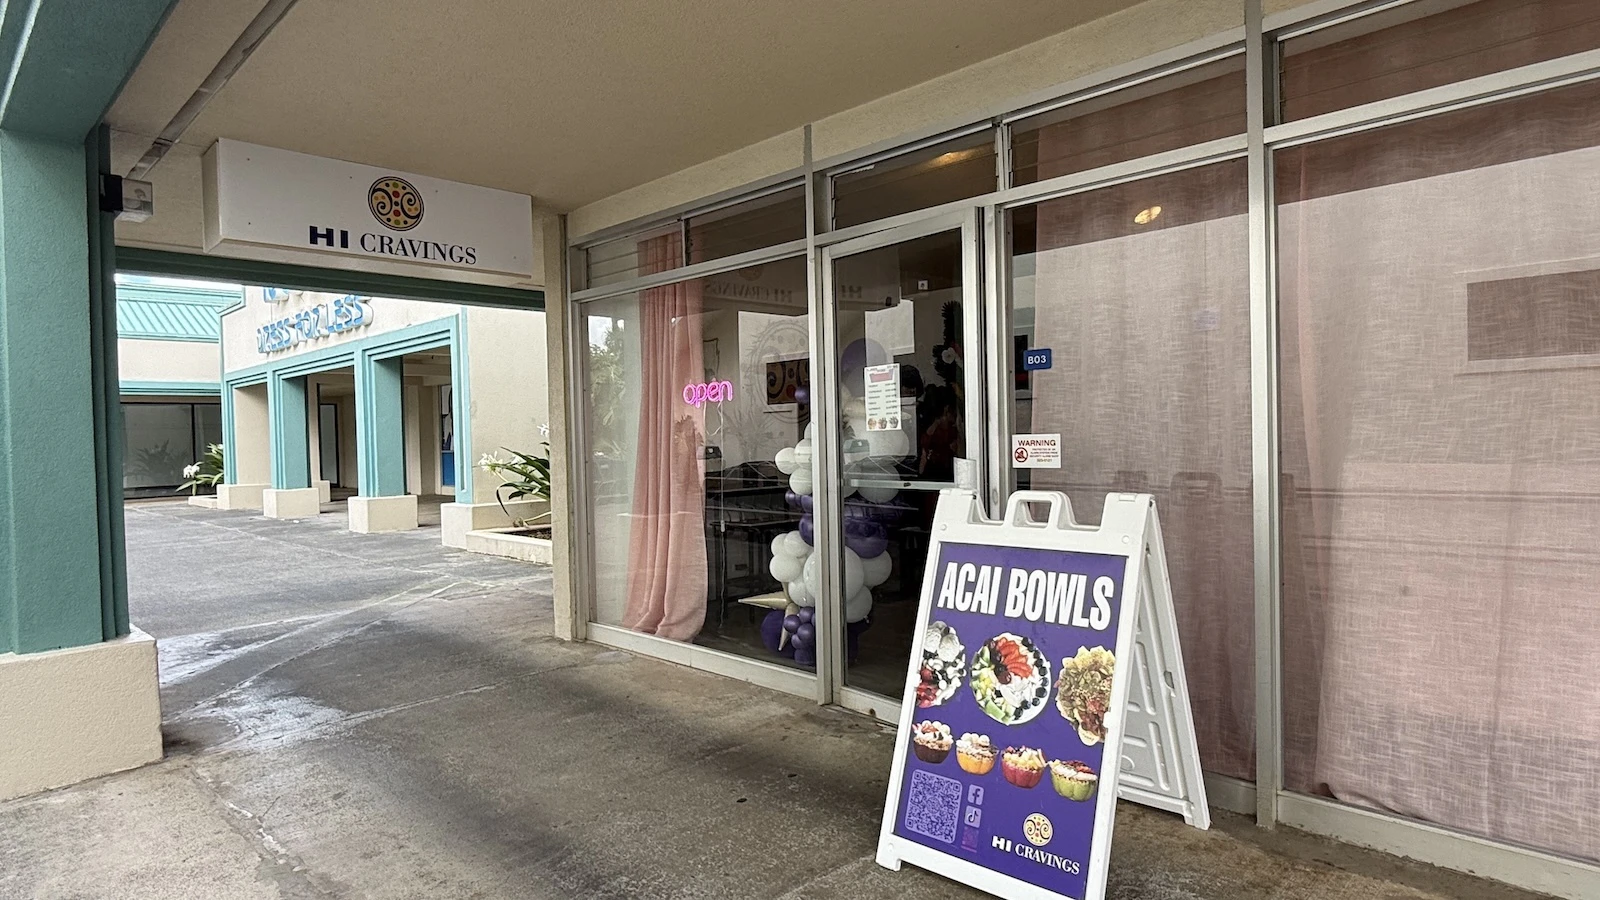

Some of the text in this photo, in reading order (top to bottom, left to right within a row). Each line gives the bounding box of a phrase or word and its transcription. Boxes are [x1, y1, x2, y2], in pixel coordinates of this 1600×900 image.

[309, 225, 477, 265] HI CRAVINGS
[326, 295, 367, 334] LESS
[1027, 355, 1047, 365] B03
[683, 381, 733, 408] open
[1017, 439, 1056, 447] WARNING
[937, 562, 1114, 631] ACAI BOWLS
[992, 835, 1080, 875] HI CRAVINGS
